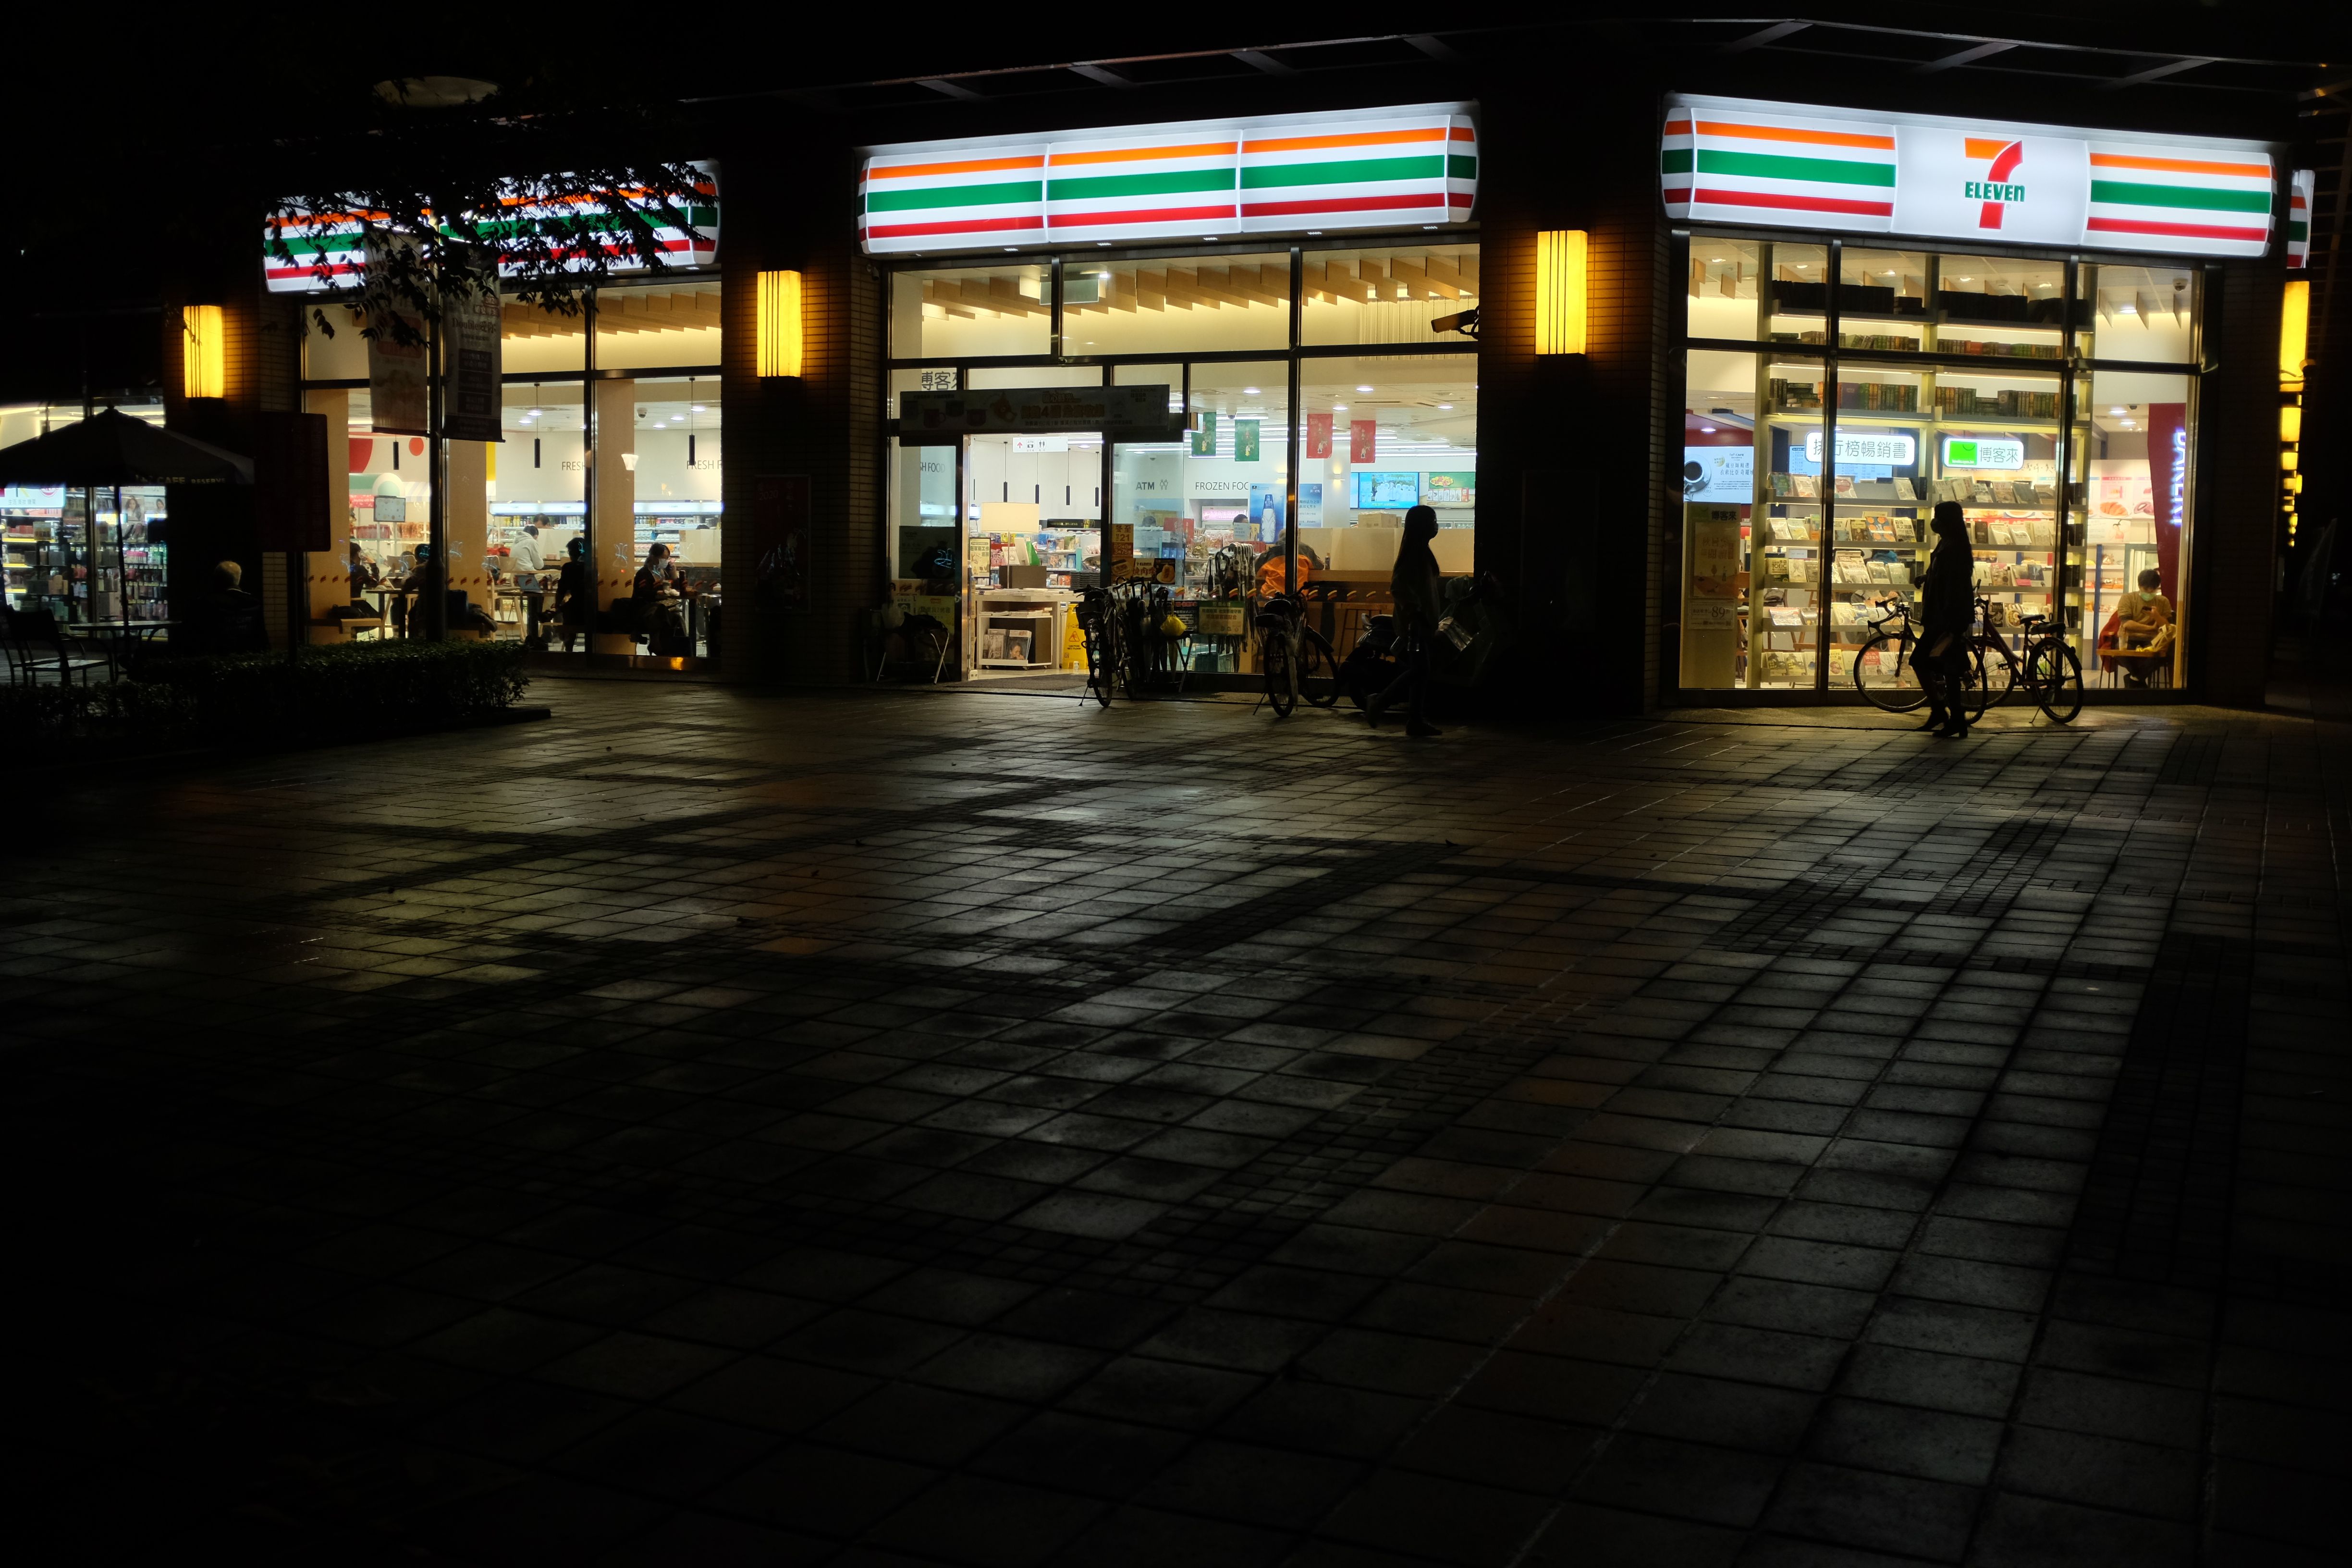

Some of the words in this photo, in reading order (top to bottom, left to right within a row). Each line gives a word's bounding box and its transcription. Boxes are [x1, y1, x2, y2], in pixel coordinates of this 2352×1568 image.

[1980, 447, 2019, 463] 博客來
[1136, 481, 1154, 491] ATM
[1195, 482, 1230, 490] FROZEN
[1711, 510, 1737, 520] 博客來
